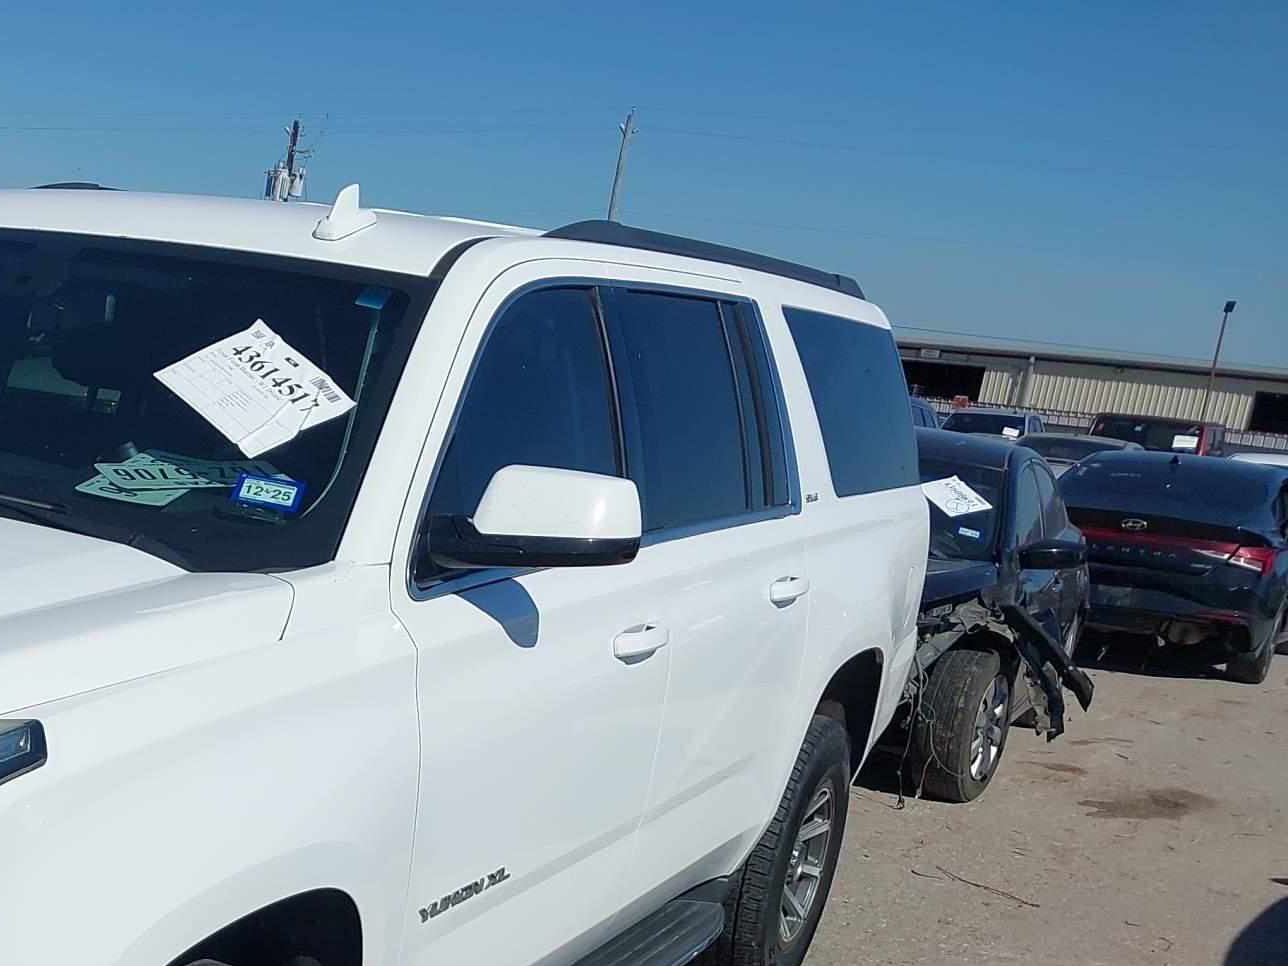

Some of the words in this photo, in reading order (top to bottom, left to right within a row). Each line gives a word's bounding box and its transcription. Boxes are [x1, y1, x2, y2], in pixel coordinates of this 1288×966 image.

[232, 345, 320, 411] 43614517
[418, 877, 484, 923] YUKON
[484, 867, 511, 890] XL
